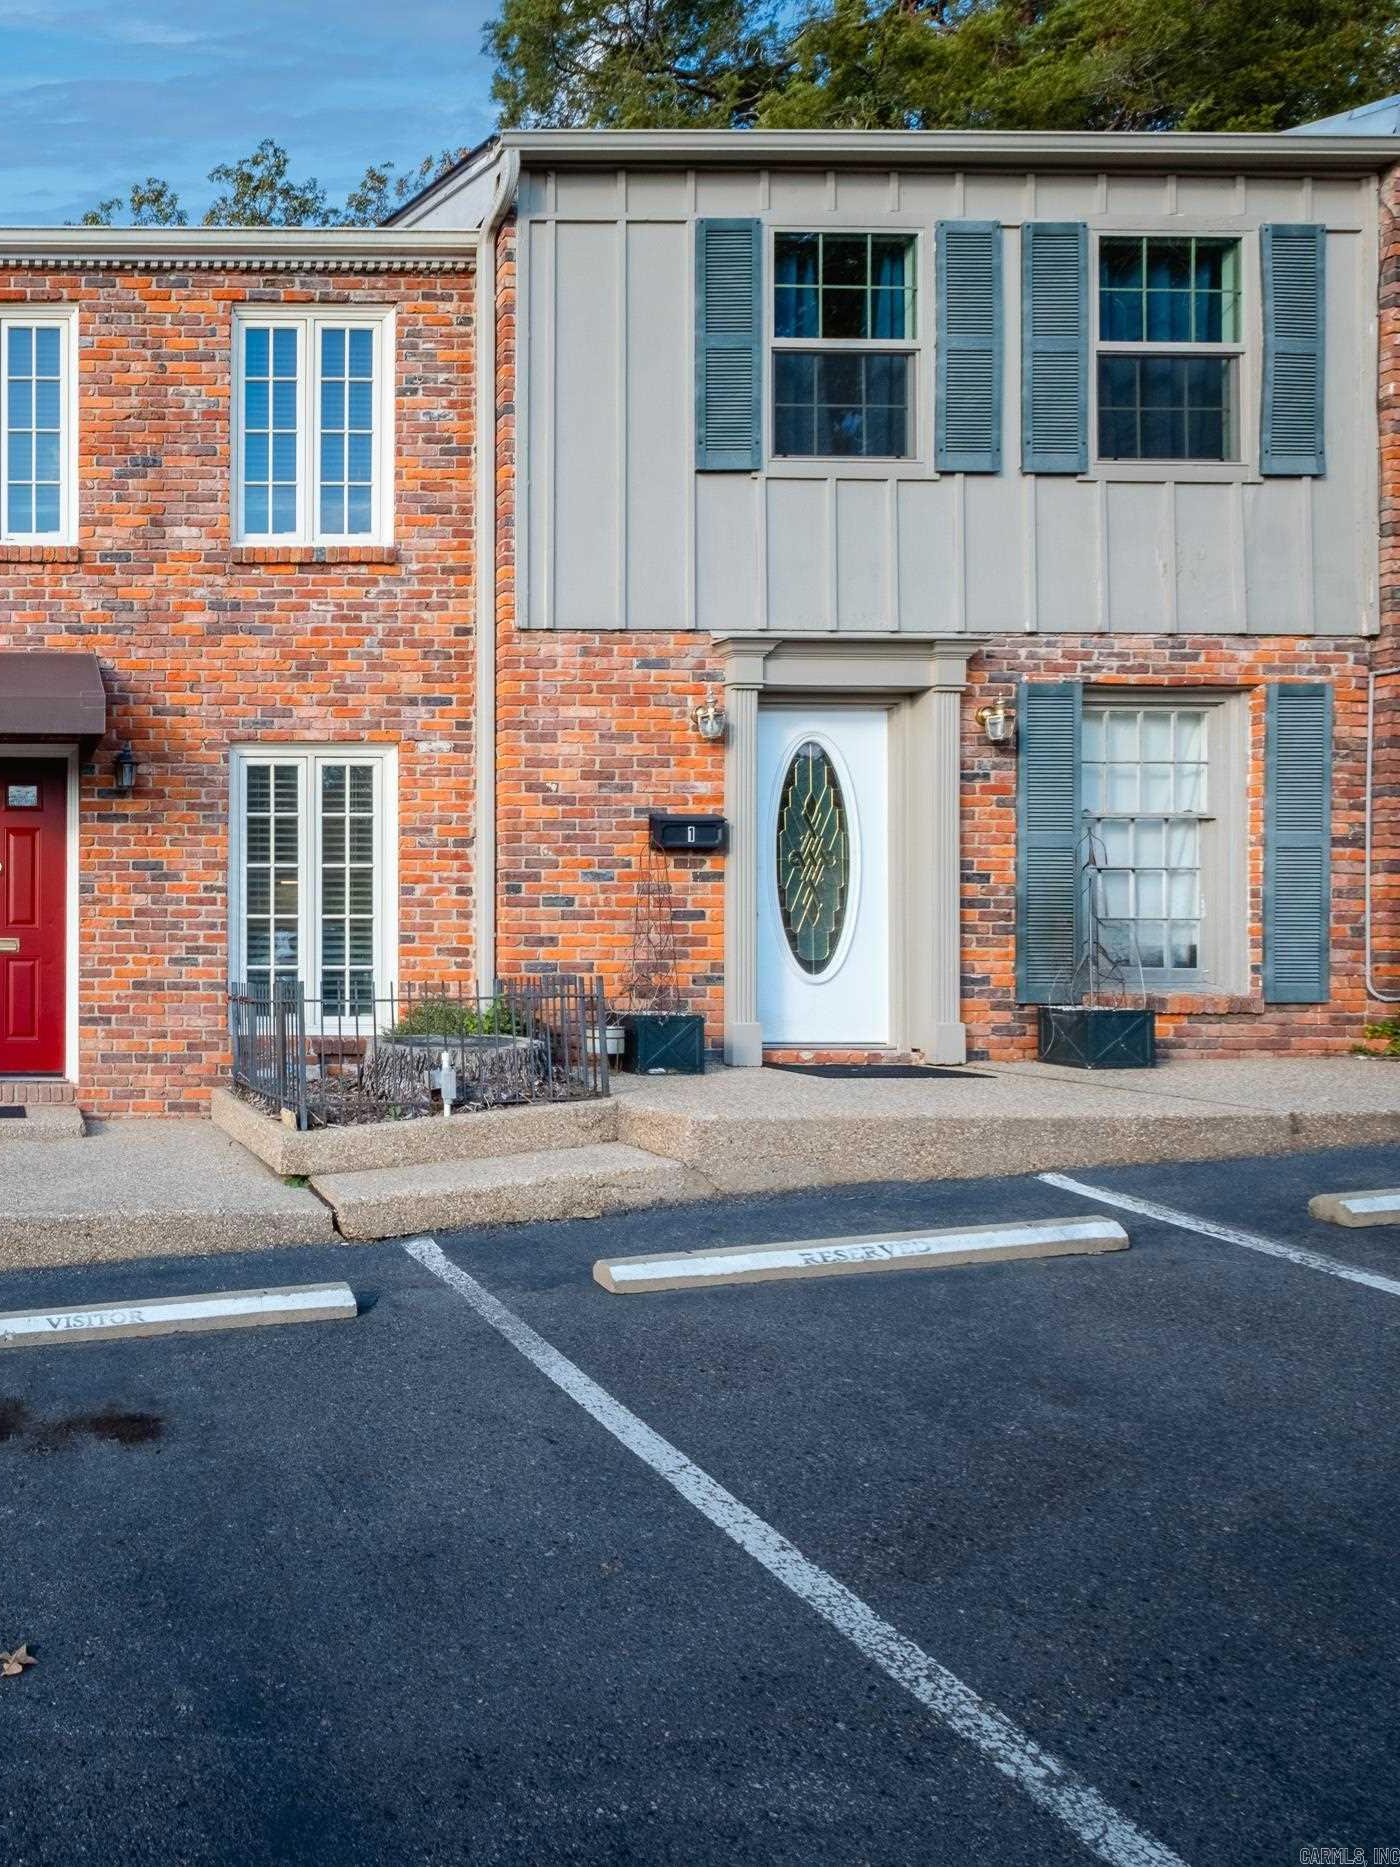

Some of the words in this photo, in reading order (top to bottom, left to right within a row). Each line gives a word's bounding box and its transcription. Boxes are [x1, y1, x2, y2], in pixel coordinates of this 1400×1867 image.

[688, 826, 696, 843] 1
[799, 1241, 931, 1265] RESERVED
[47, 1310, 146, 1330] VISITOR
